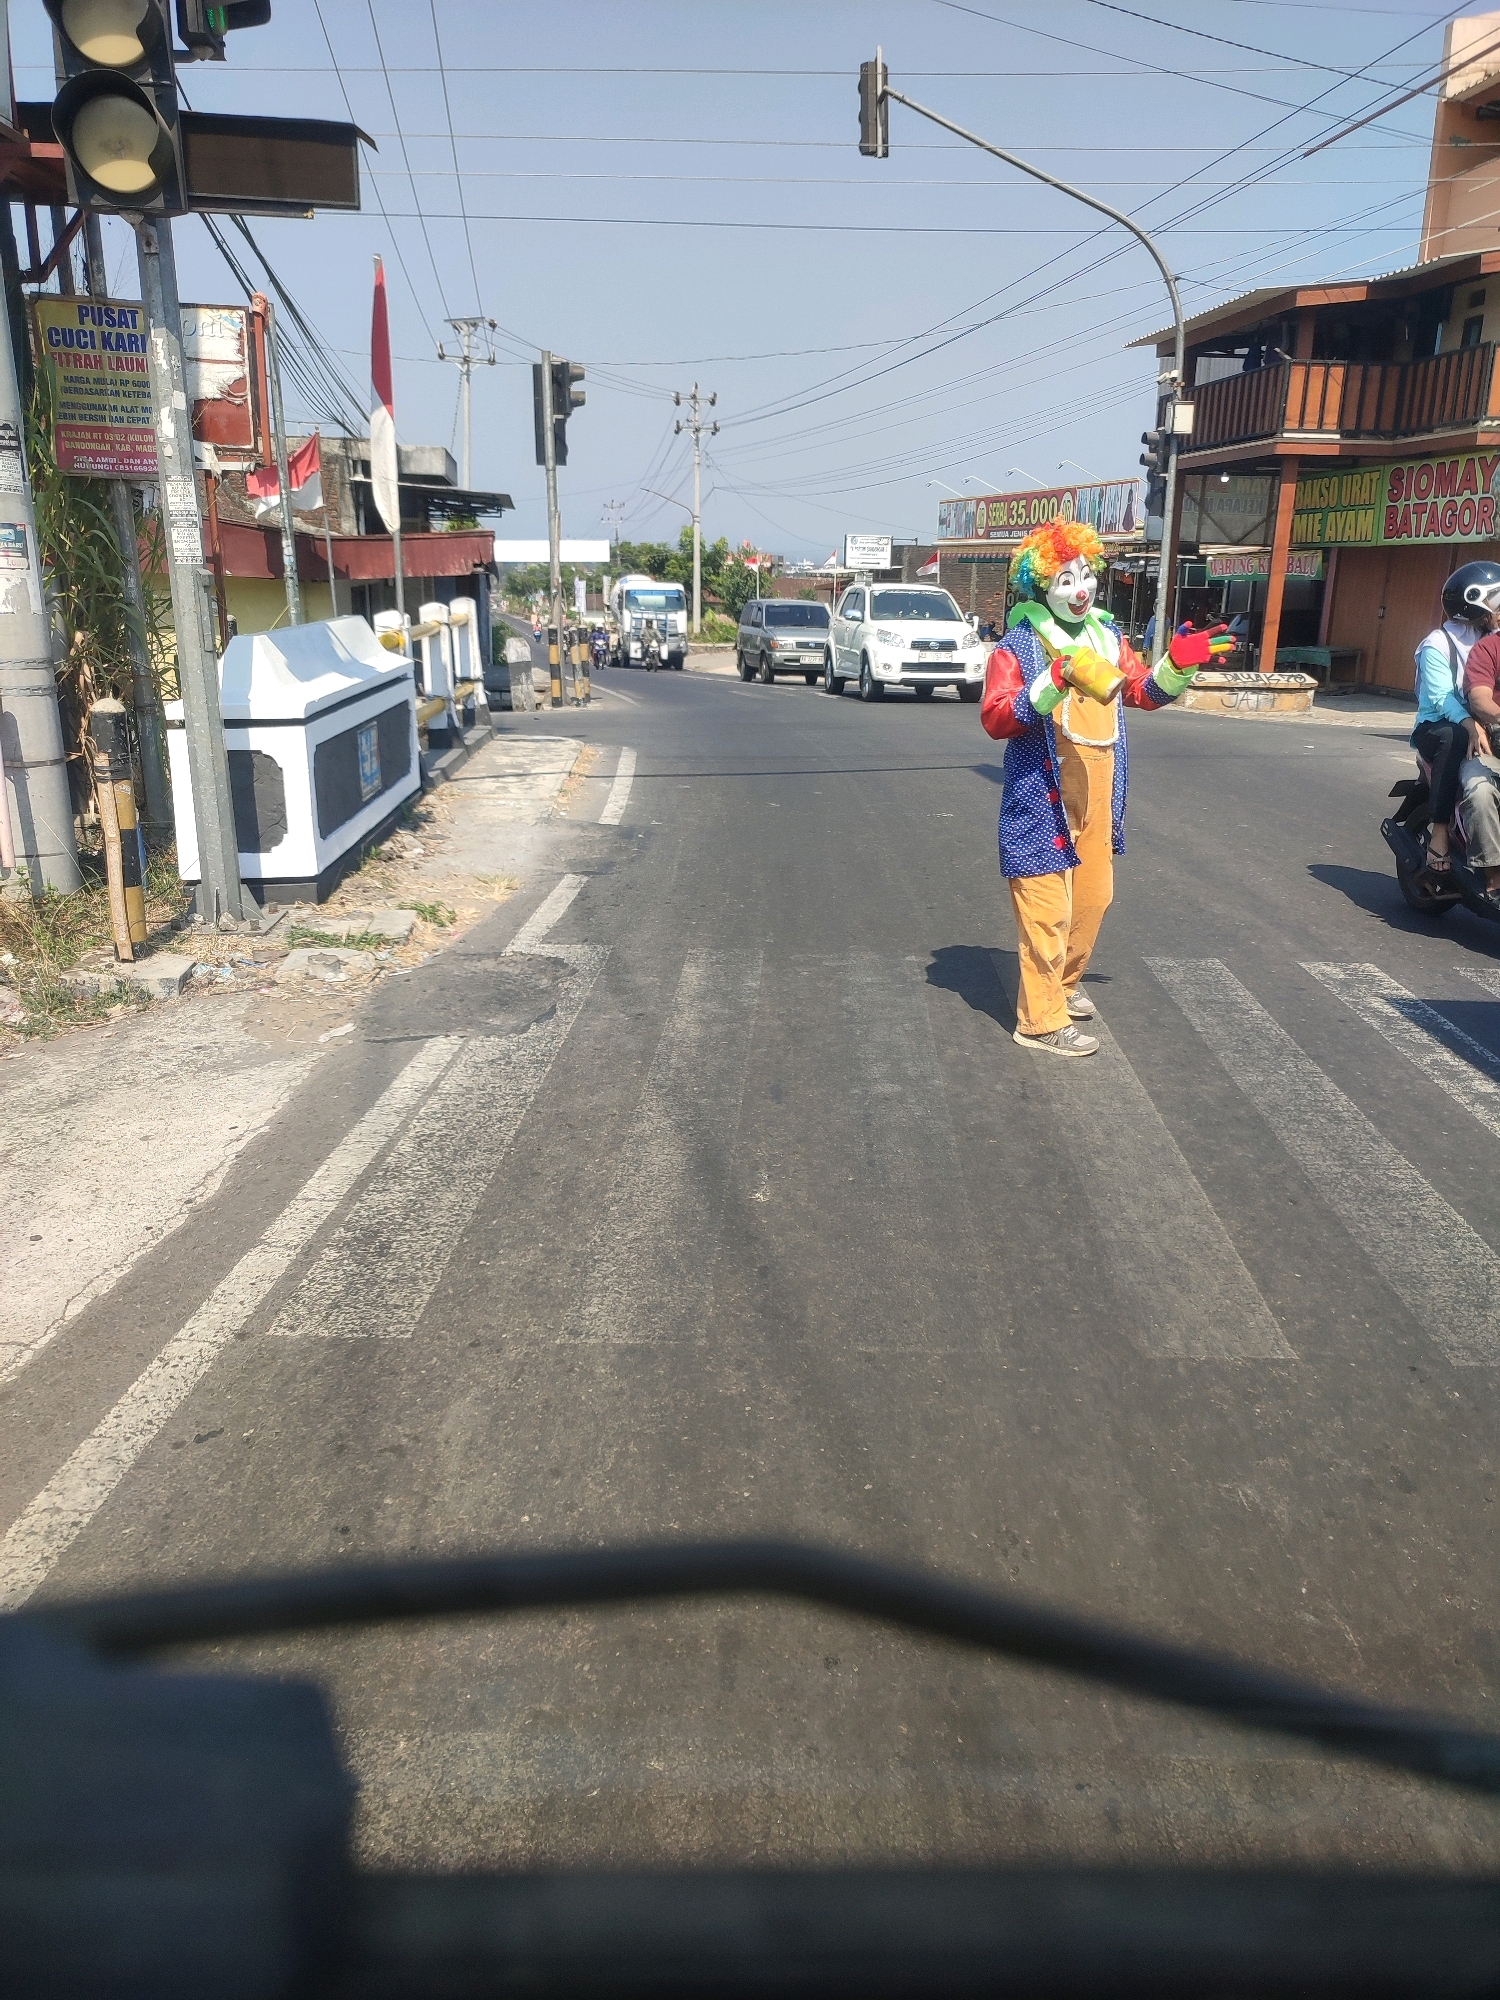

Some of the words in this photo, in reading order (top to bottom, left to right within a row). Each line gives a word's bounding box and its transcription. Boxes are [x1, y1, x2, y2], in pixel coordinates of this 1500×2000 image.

[77, 304, 139, 329] PUSAT
[47, 326, 97, 350] CUCI
[61, 386, 121, 397] (BERDASARKAN
[64, 375, 91, 385] HARGA
[93, 377, 117, 386] MULAI
[120, 379, 129, 387] RP
[60, 401, 118, 412] MENGGUNAKAN
[121, 405, 138, 413] ALAT
[79, 413, 106, 422] BERSIH
[109, 415, 124, 424] DAN
[127, 416, 150, 425] CEPAT
[61, 430, 91, 440] KRAJAN
[93, 432, 102, 440] RT
[1387, 453, 1500, 503] SIOMAY
[1296, 476, 1338, 510] BAKSO
[1342, 470, 1381, 507] URAT
[988, 501, 1008, 527] SERBA
[1009, 496, 1058, 526] 35.000
[1384, 496, 1495, 540] BATAGOR
[989, 530, 1009, 538] SEMUA
[1010, 529, 1030, 538] JENIS
[1292, 511, 1322, 543] MIE
[1324, 508, 1375, 542] AYAM
[1210, 557, 1255, 577] WARUNG
[1258, 555, 1319, 577] KIBALU
